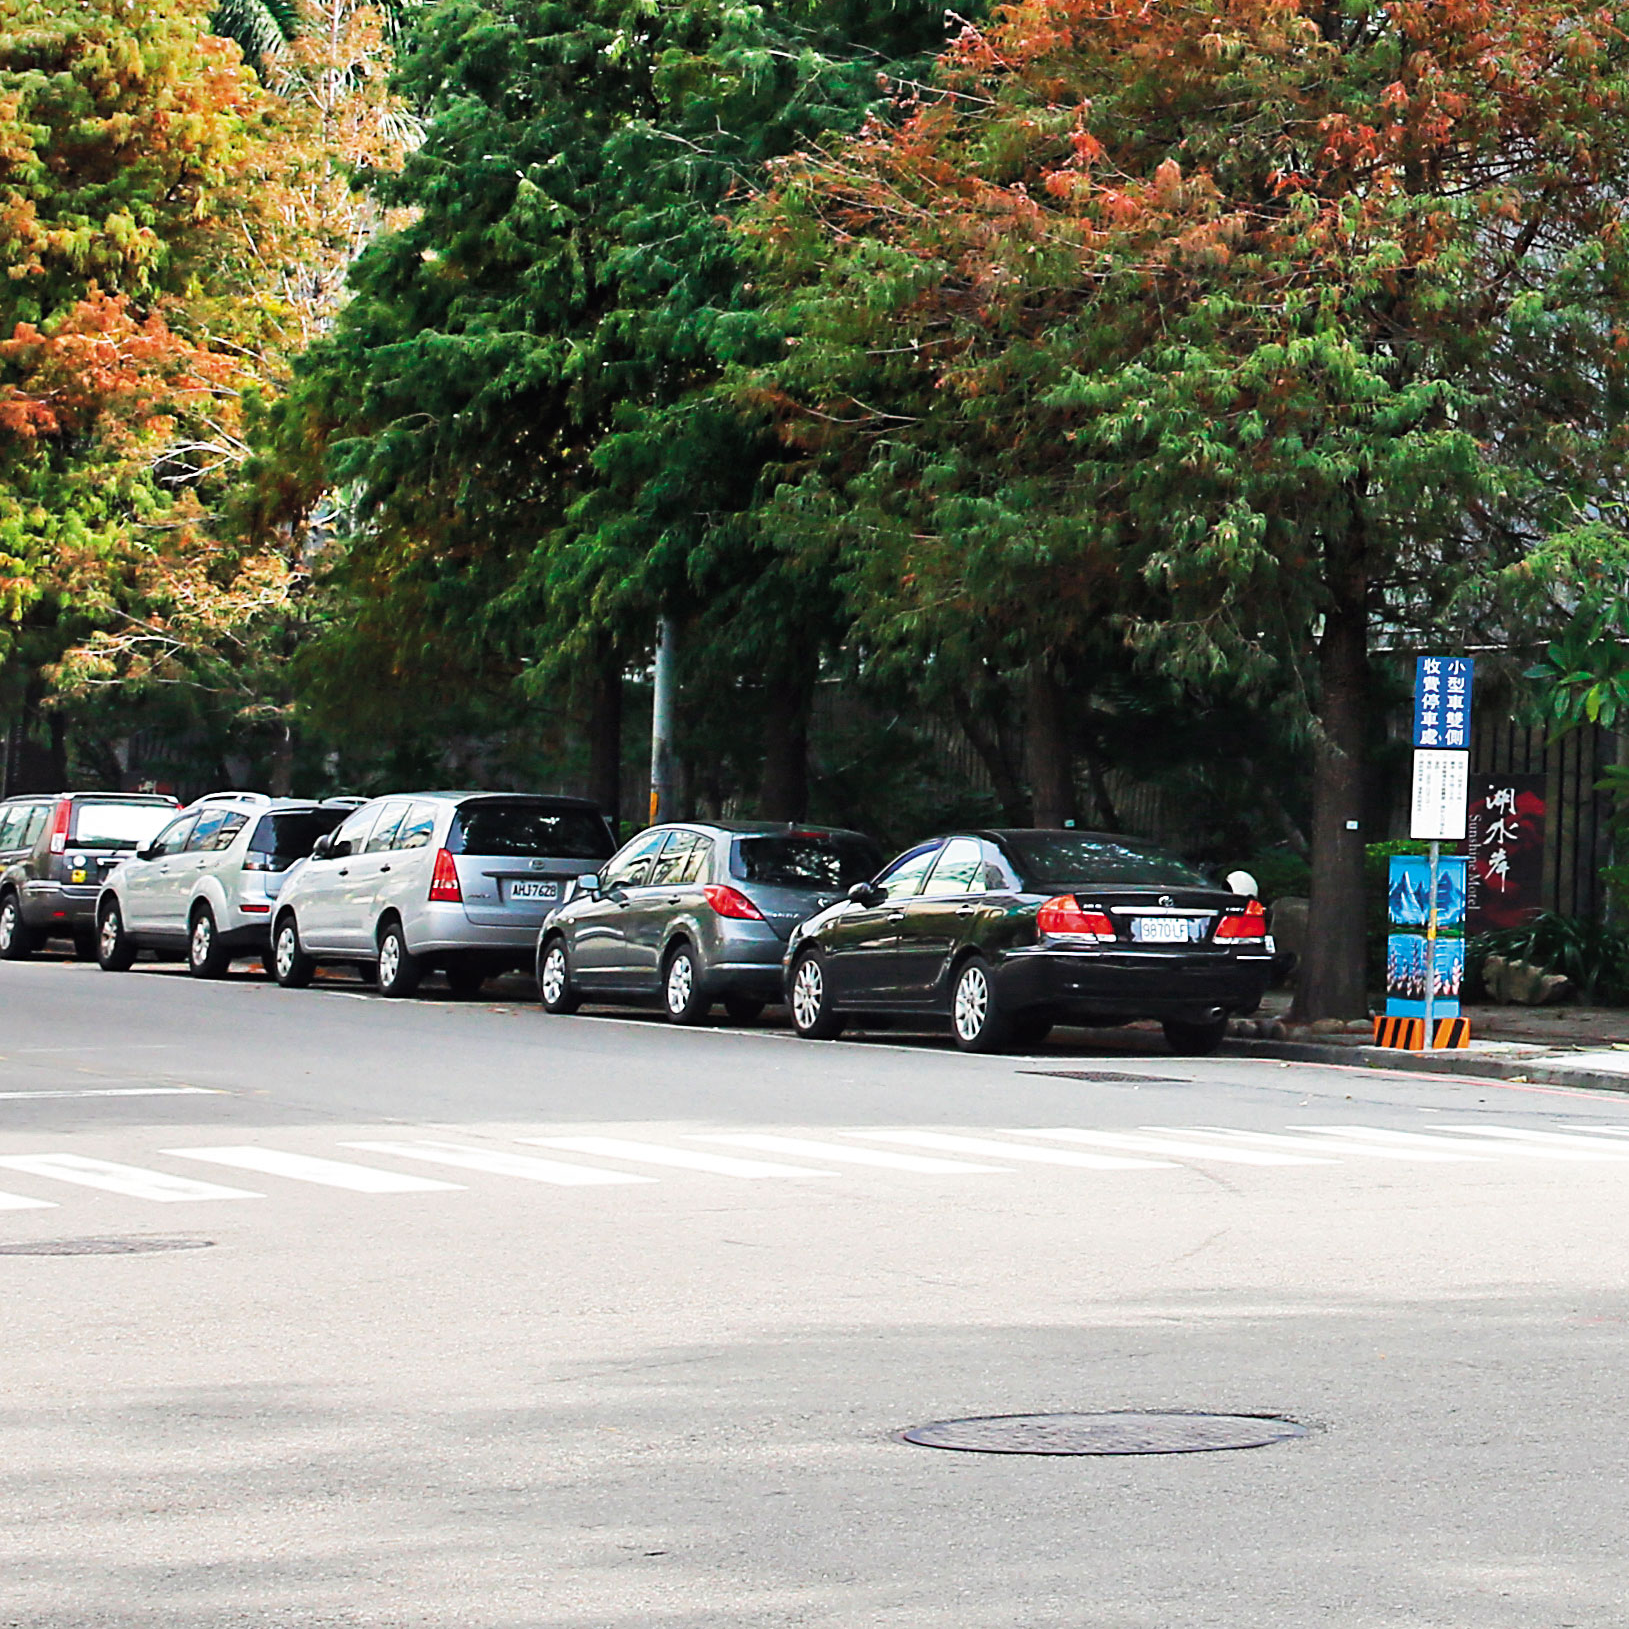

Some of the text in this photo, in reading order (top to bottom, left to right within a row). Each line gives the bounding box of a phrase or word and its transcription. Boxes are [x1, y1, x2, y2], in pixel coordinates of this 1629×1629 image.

[1420, 657, 1442, 745] 收費停車處
[1445, 659, 1466, 746] 小型車雙側
[1467, 814, 1482, 910] Sunshine Motel
[1483, 784, 1520, 893] 湖水岸
